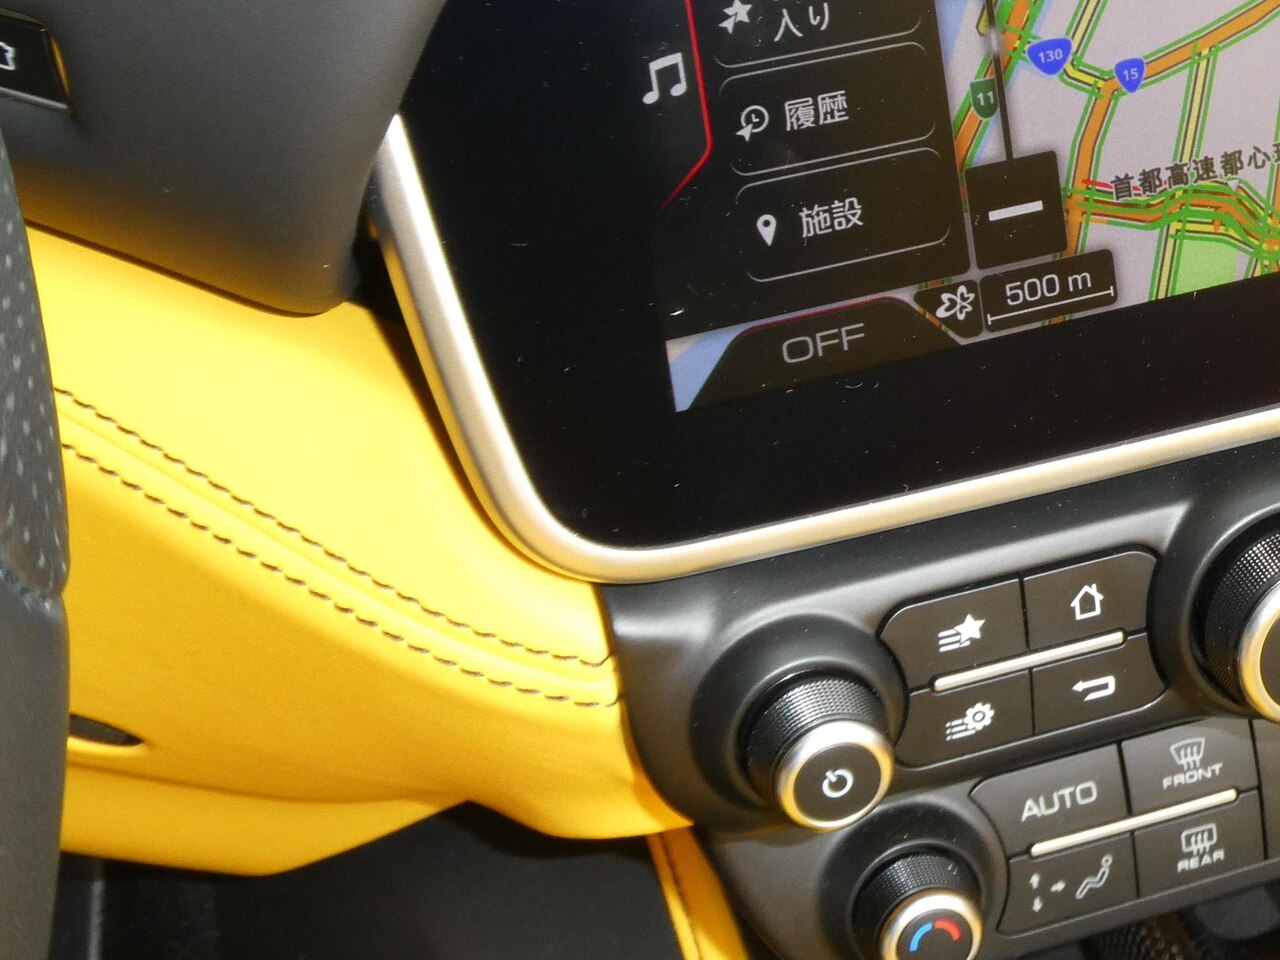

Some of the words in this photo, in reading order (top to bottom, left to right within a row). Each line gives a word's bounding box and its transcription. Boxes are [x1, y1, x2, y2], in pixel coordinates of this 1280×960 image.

[773, 3, 831, 42] 入り
[1038, 48, 1063, 63] 130
[1122, 68, 1139, 81] 15
[784, 90, 850, 132] 履歴
[977, 91, 994, 106] 11
[799, 197, 863, 239] 施設
[1005, 277, 1060, 306] 500
[1068, 272, 1092, 292] m
[781, 323, 865, 364] OFF
[1162, 763, 1223, 791] FRONT
[1021, 781, 1098, 822] AUTO
[1177, 848, 1225, 874] REAR
